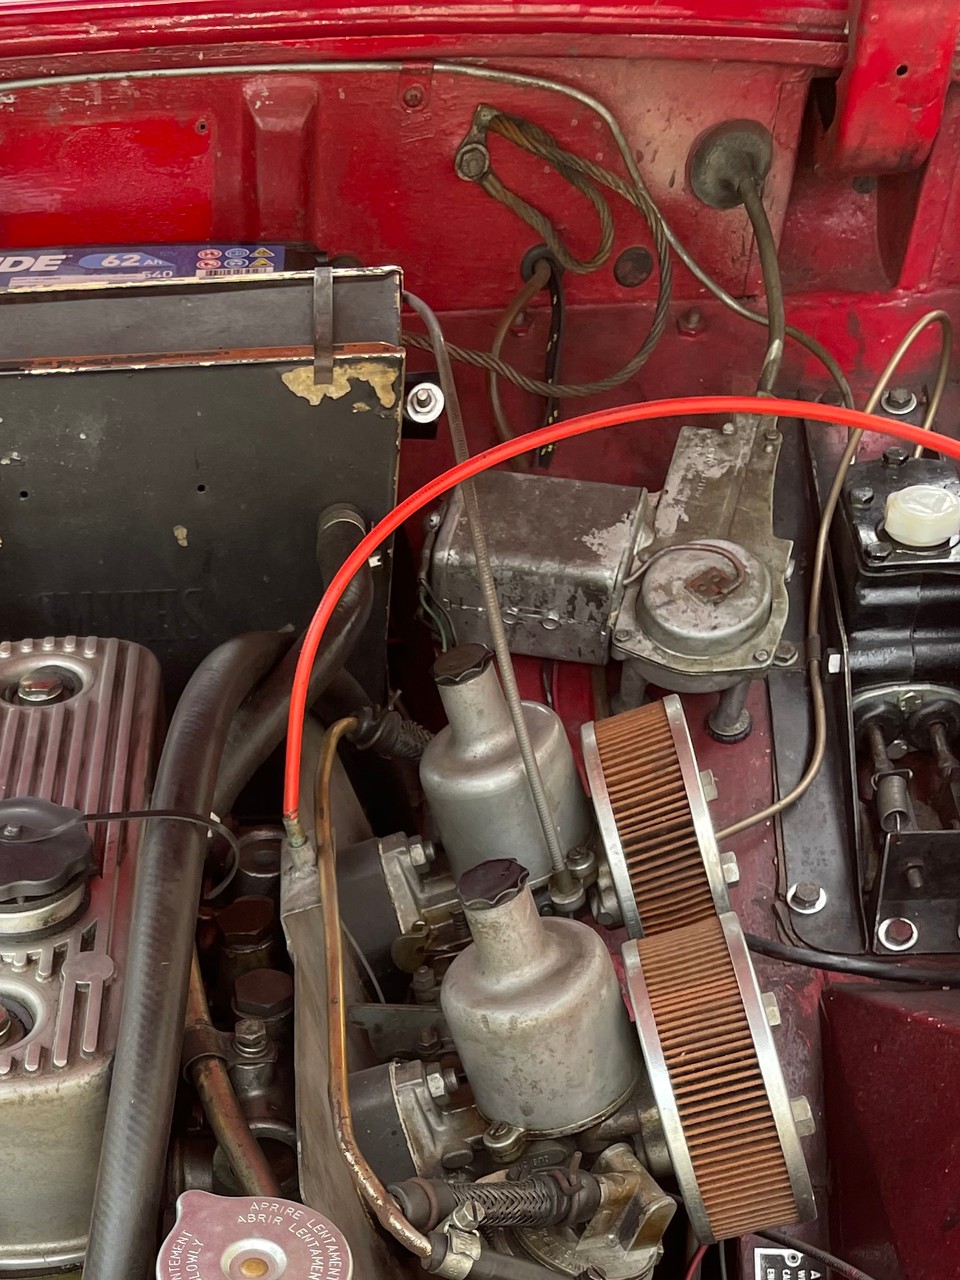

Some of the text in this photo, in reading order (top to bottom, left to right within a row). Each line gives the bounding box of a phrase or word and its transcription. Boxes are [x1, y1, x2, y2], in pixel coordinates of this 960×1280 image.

[101, 254, 164, 267] 62 Ah
[249, 1201, 305, 1221] APRIRE
[237, 1214, 284, 1226] ABRIR
